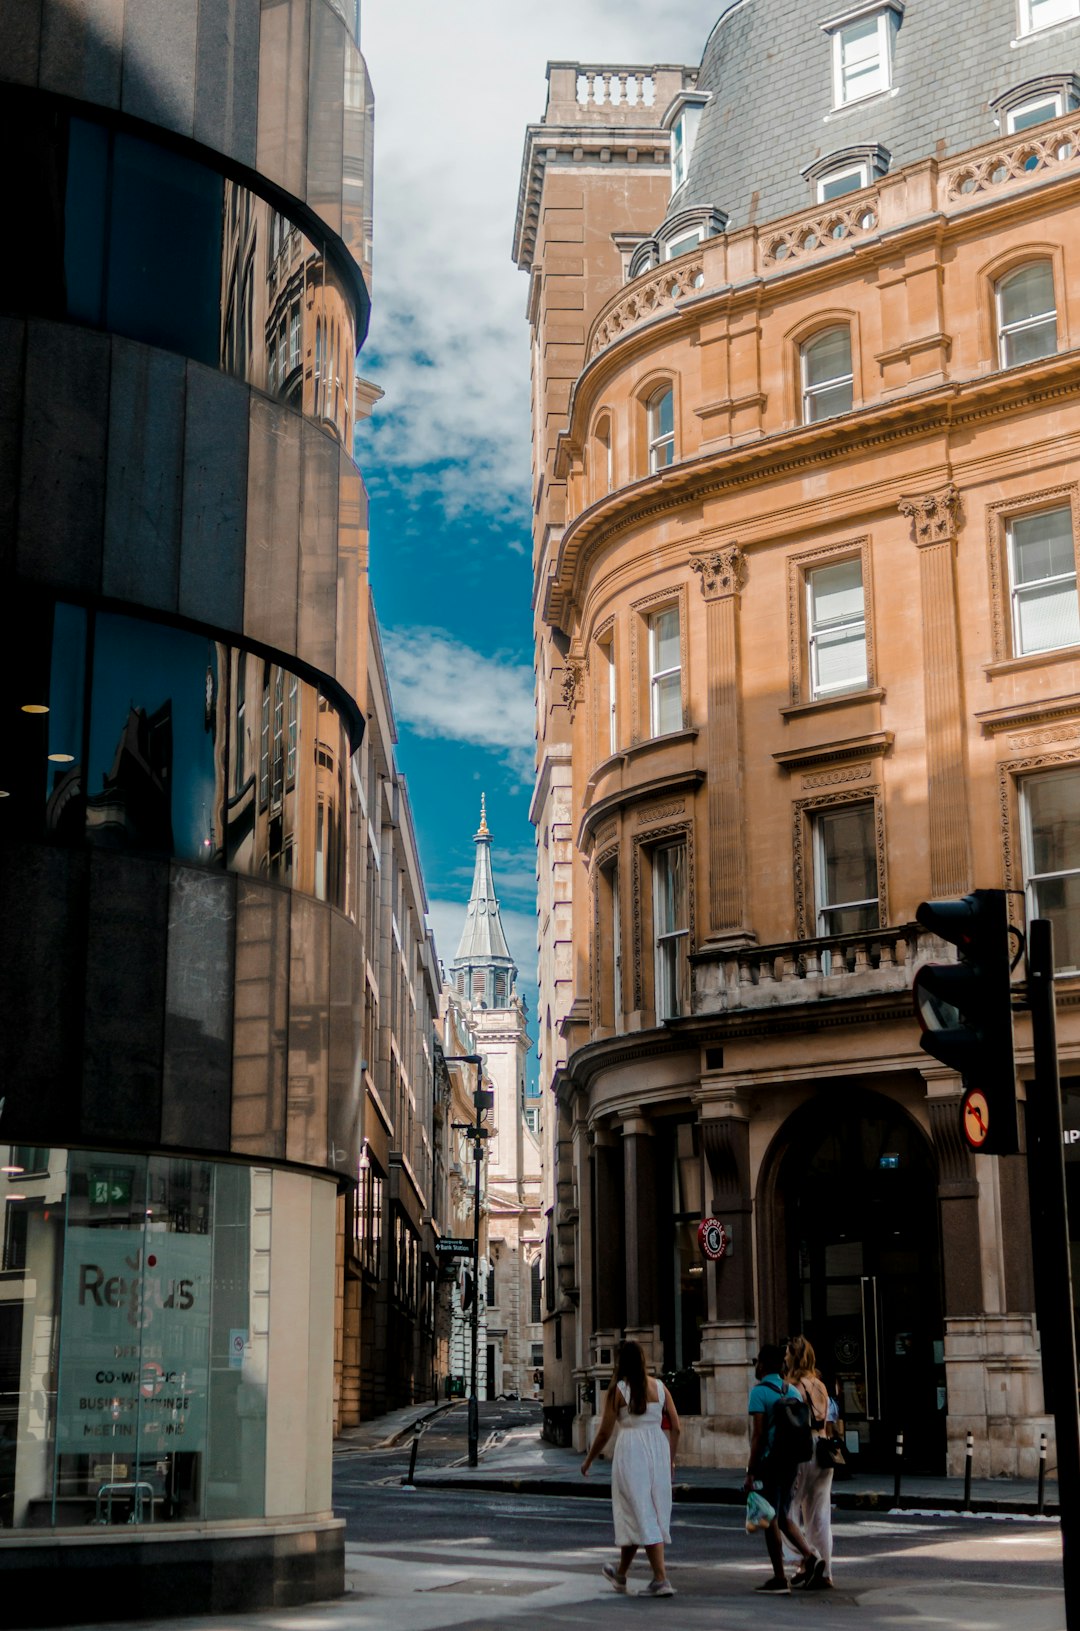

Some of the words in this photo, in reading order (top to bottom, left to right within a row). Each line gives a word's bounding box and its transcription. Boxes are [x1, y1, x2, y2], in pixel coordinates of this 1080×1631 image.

[702, 1219, 725, 1235] CHIPOTLE
[79, 1263, 195, 1329] Regus
[83, 1423, 137, 1437] MEETIN
